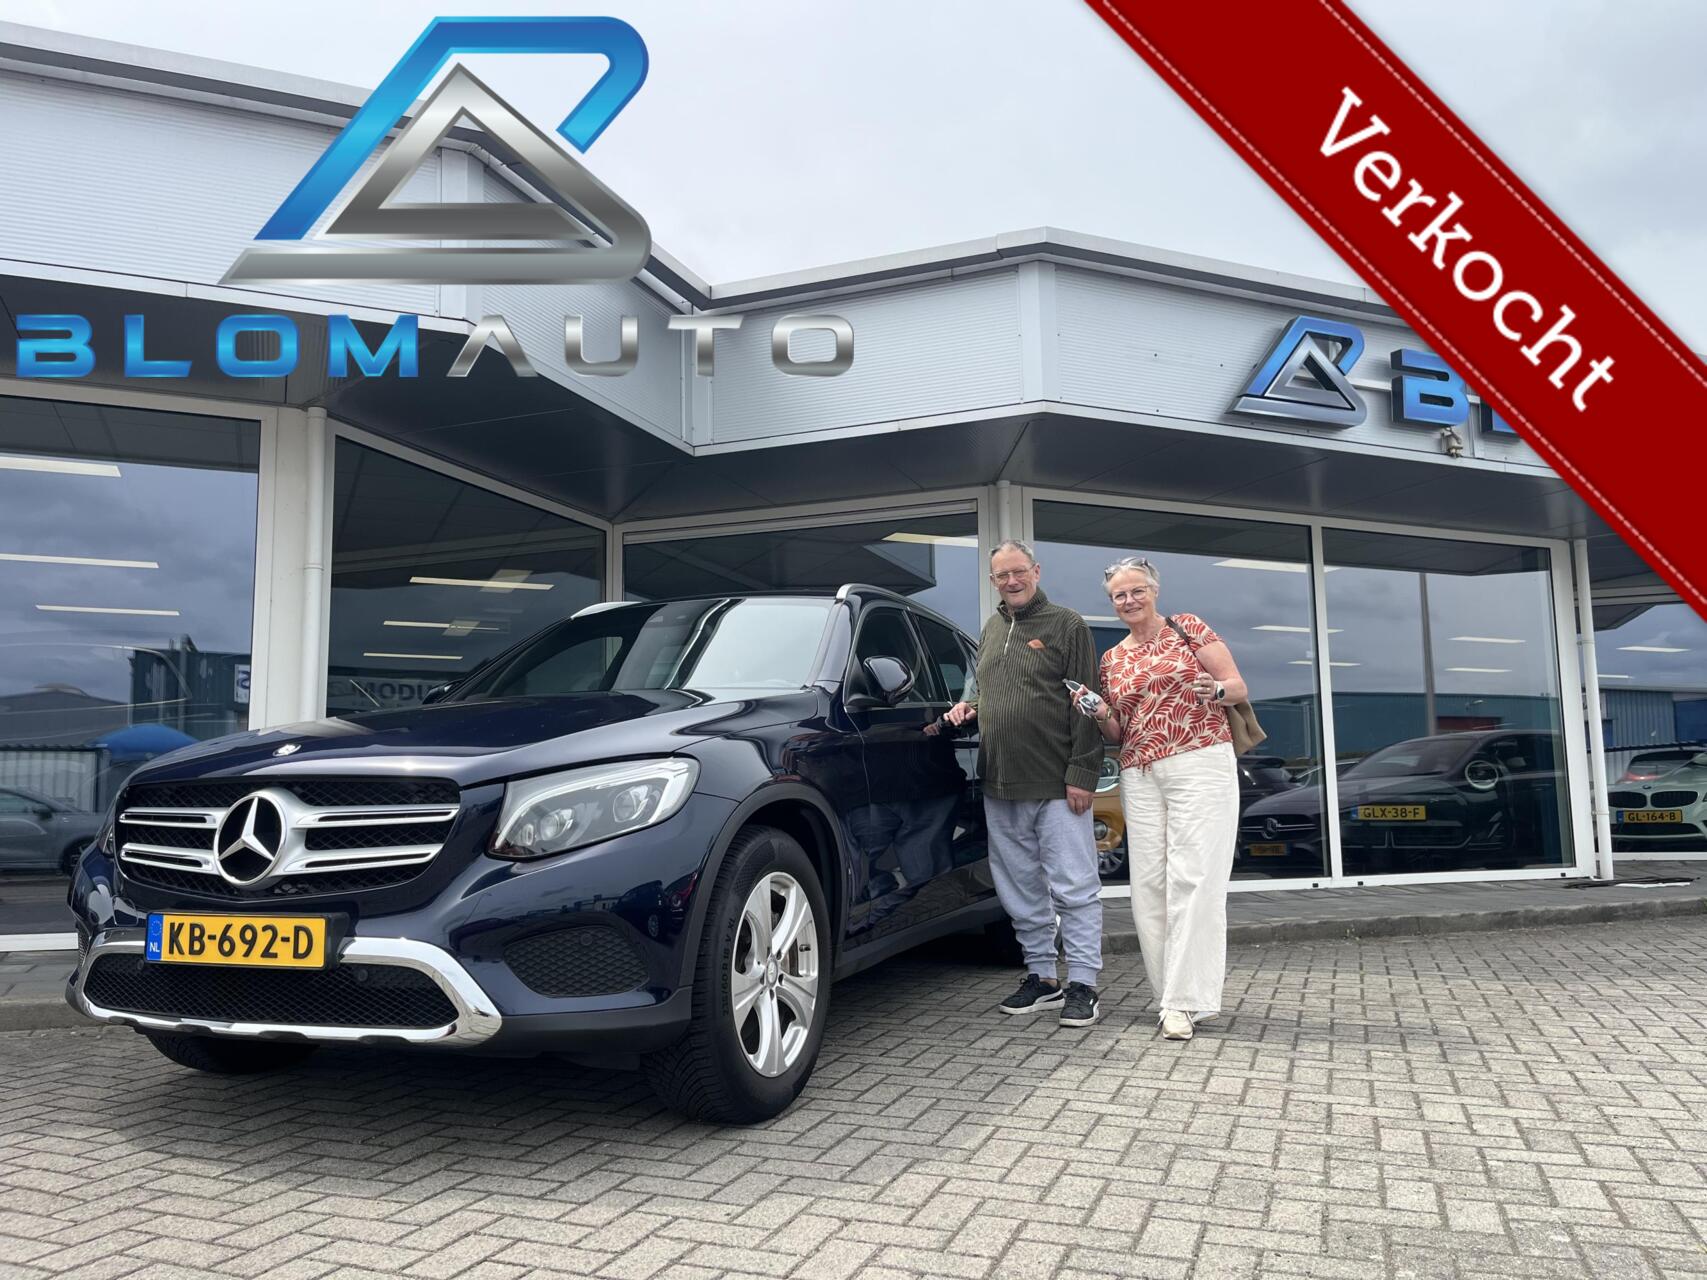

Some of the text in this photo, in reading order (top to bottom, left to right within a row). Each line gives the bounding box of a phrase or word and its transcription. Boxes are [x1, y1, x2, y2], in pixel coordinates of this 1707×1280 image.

[1363, 807, 1420, 818] GLX-38-F
[1627, 812, 1676, 821] GL-164-B
[168, 921, 314, 960] KB-692-D
[149, 942, 161, 953] NL
